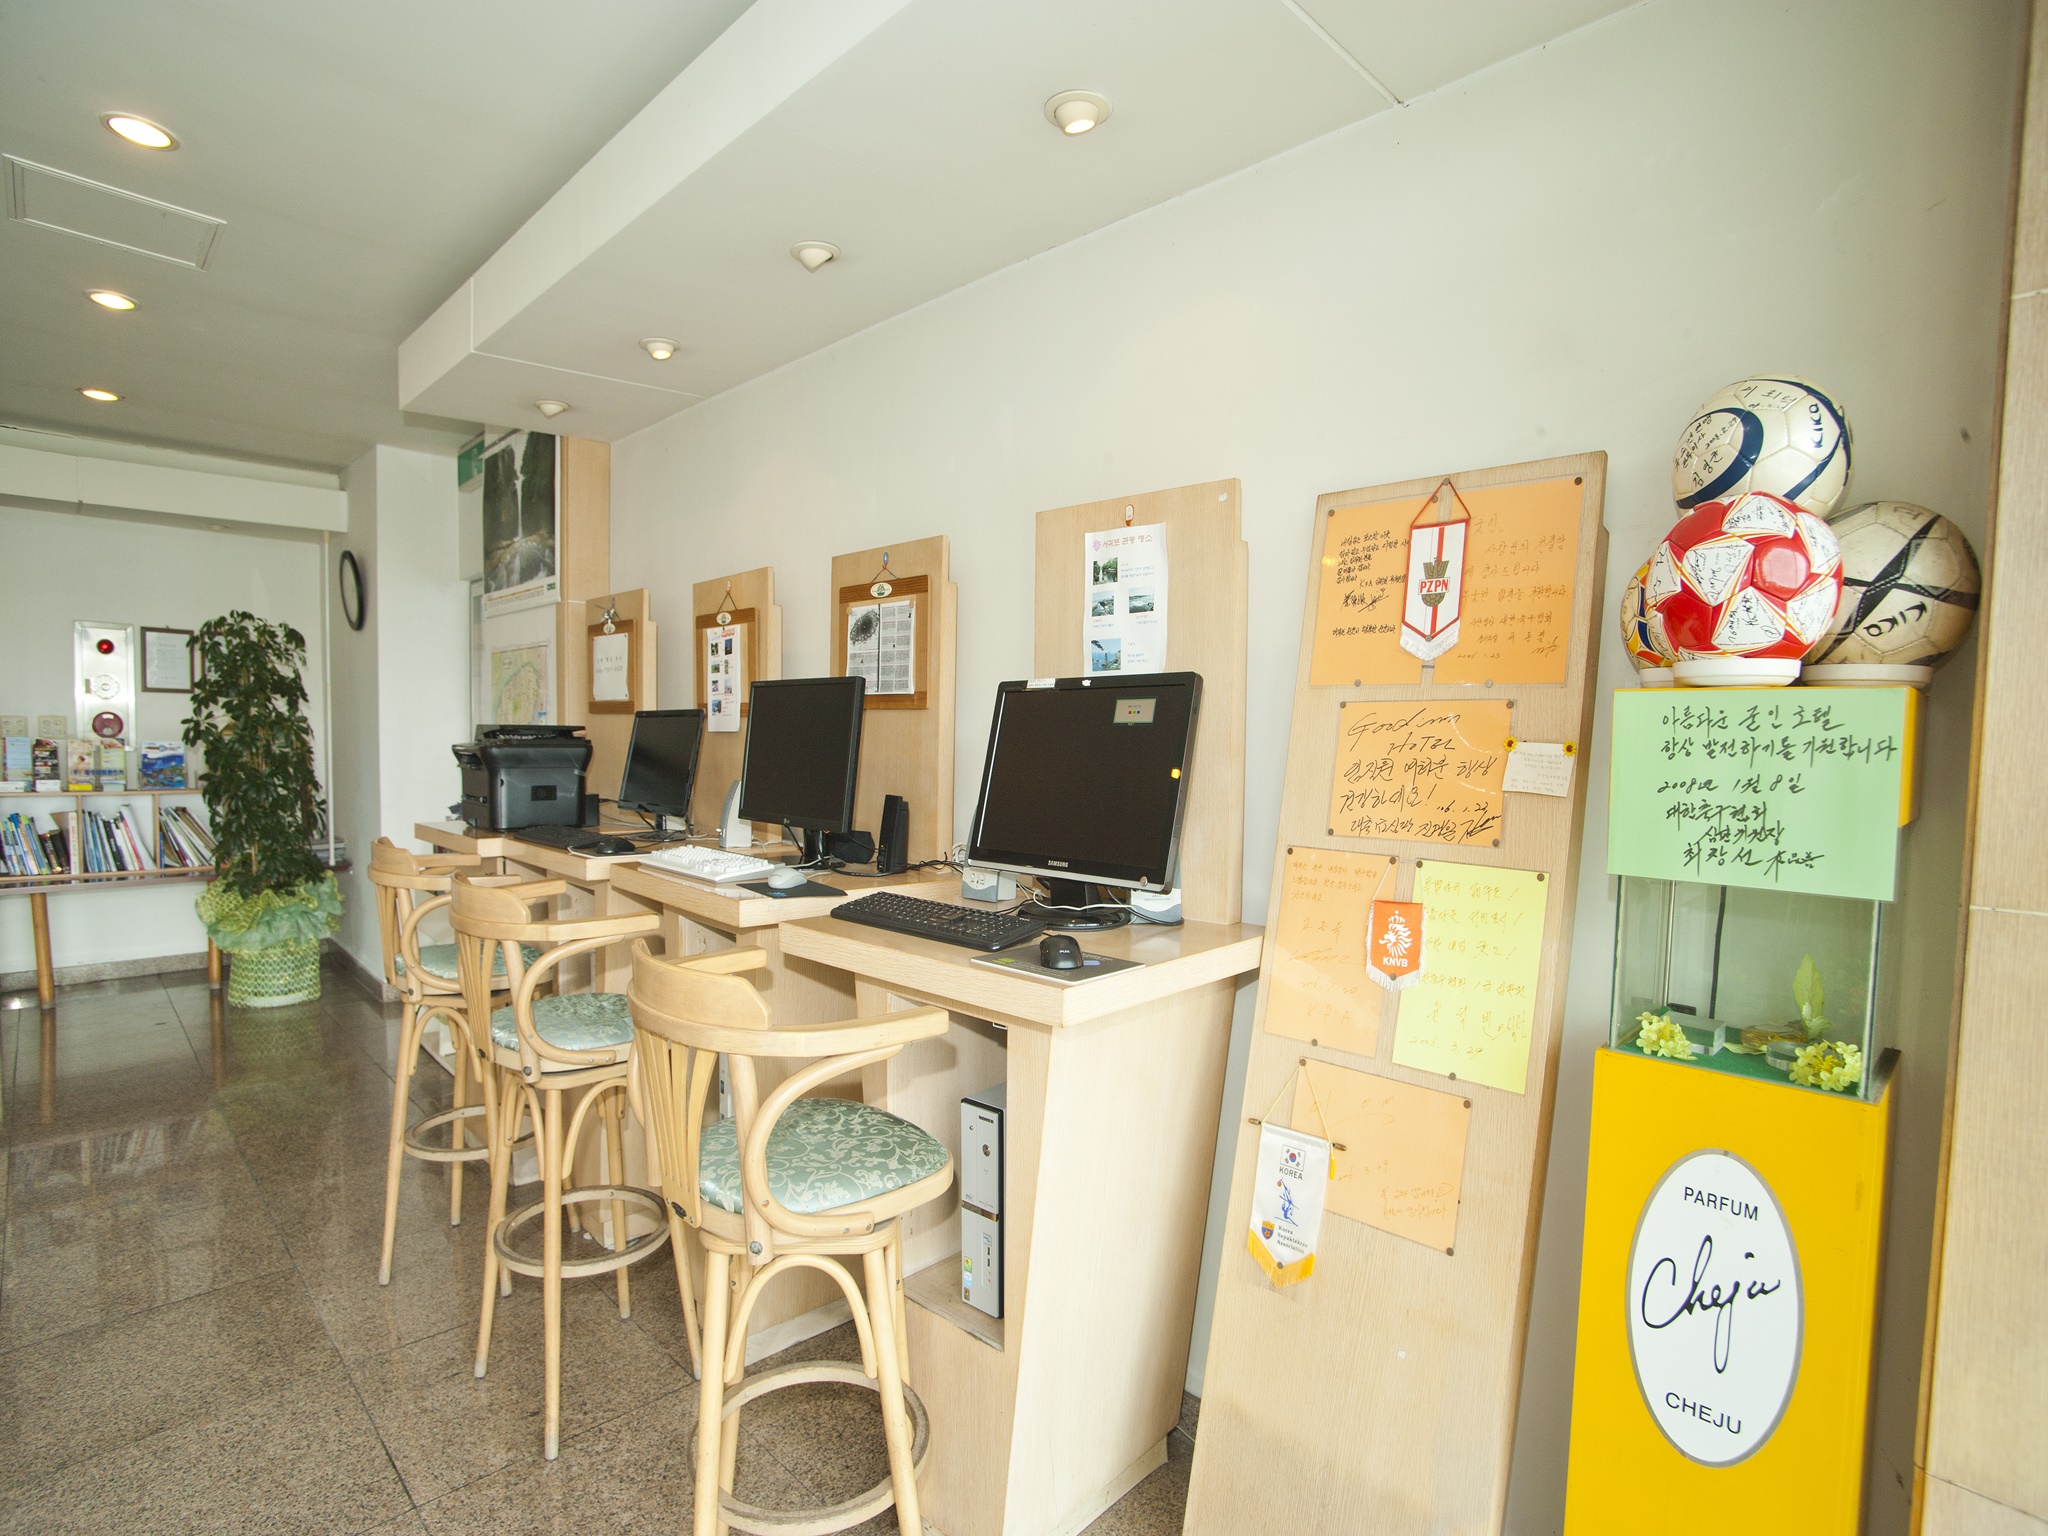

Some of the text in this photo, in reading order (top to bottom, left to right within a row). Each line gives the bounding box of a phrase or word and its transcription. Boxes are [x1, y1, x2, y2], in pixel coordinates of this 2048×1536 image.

[1102, 538, 1121, 549] 서귀포
[1121, 535, 1136, 547] 관광
[1419, 577, 1449, 594] PZPN
[1662, 705, 1729, 739] 아름다운
[1792, 705, 1846, 732] 호텔
[1660, 734, 1898, 769] 항상 발전하기를 기원합니다
[1457, 756, 1498, 778] 항상
[1731, 773, 1762, 794] 1월
[1048, 860, 1069, 868] SAMSUNG
[1383, 956, 1409, 968] KNVB
[1279, 1166, 1303, 1181] KOREA
[1683, 1185, 1759, 1222] PARFUM
[1278, 1225, 1294, 1236] Korea
[1642, 1234, 1781, 1374] Cheju
[1665, 1391, 1742, 1435] CHEJU
